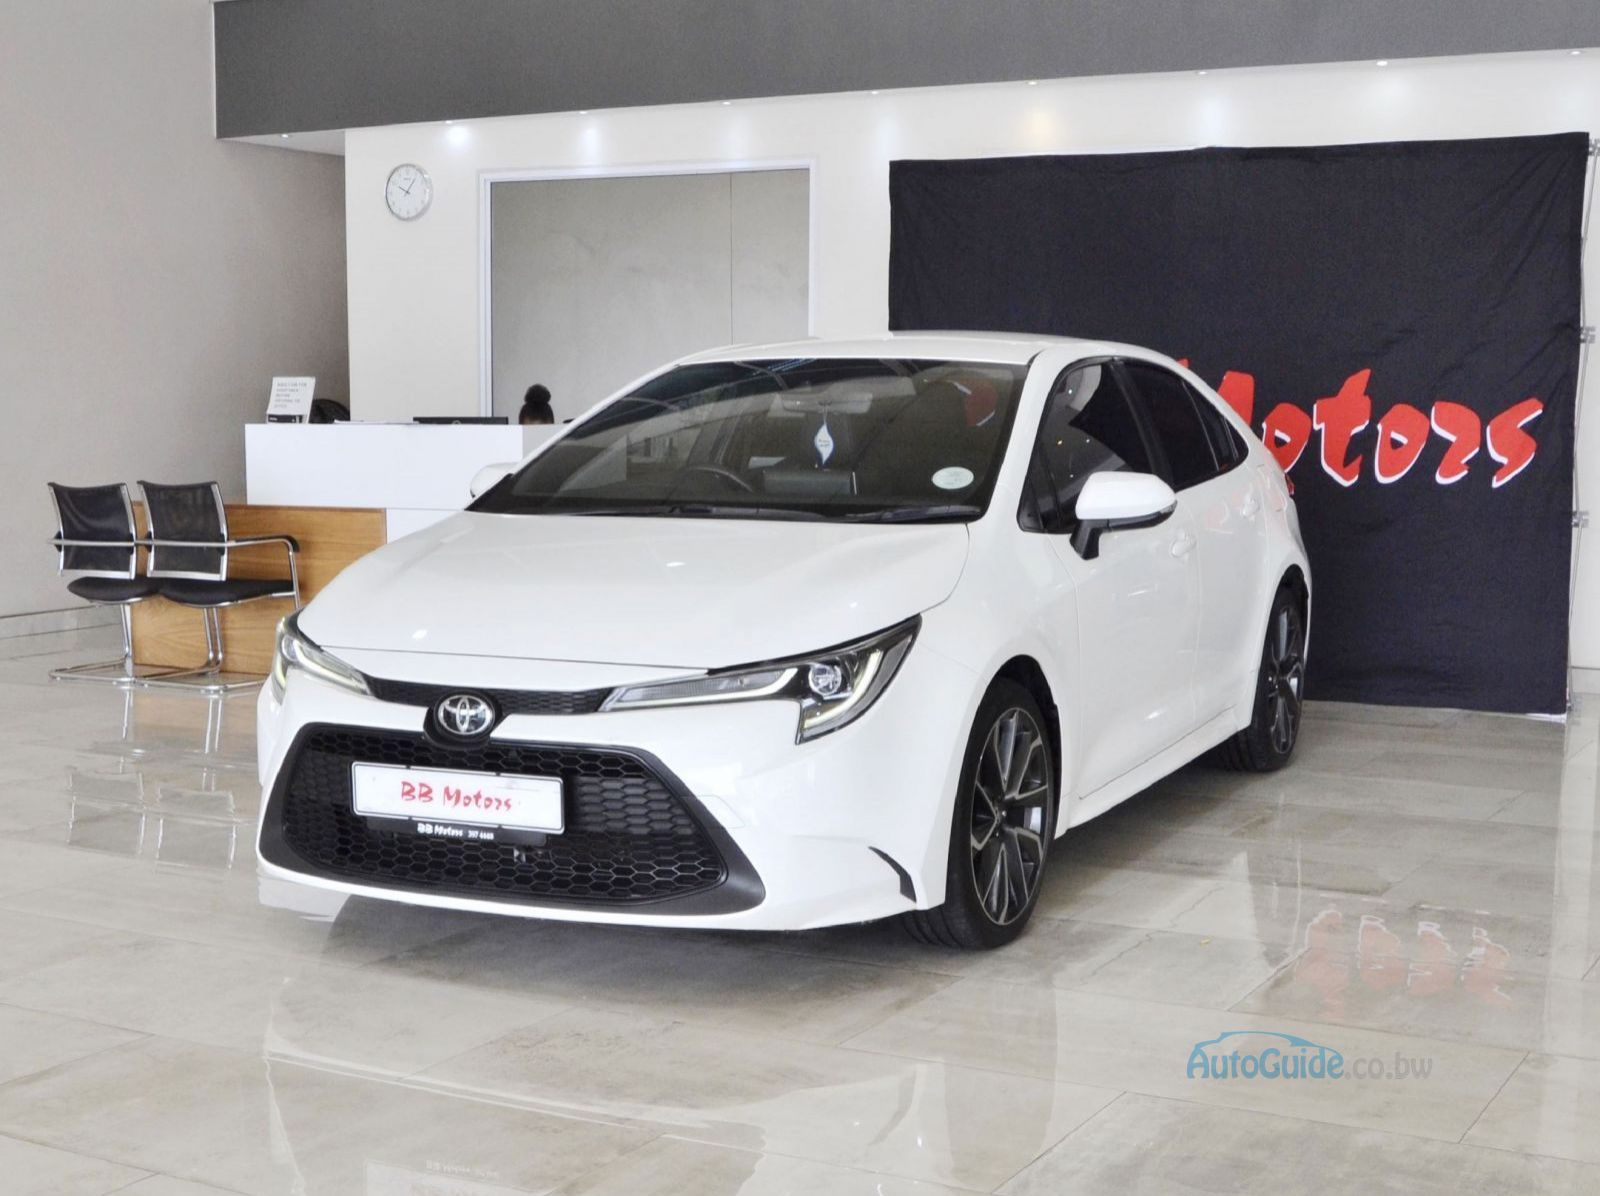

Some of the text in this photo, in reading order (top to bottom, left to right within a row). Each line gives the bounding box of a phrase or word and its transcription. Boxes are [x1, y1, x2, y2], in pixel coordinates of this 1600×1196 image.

[401, 781, 512, 811] BB Motors
[417, 822, 434, 834] BB
[434, 825, 463, 837] Motors
